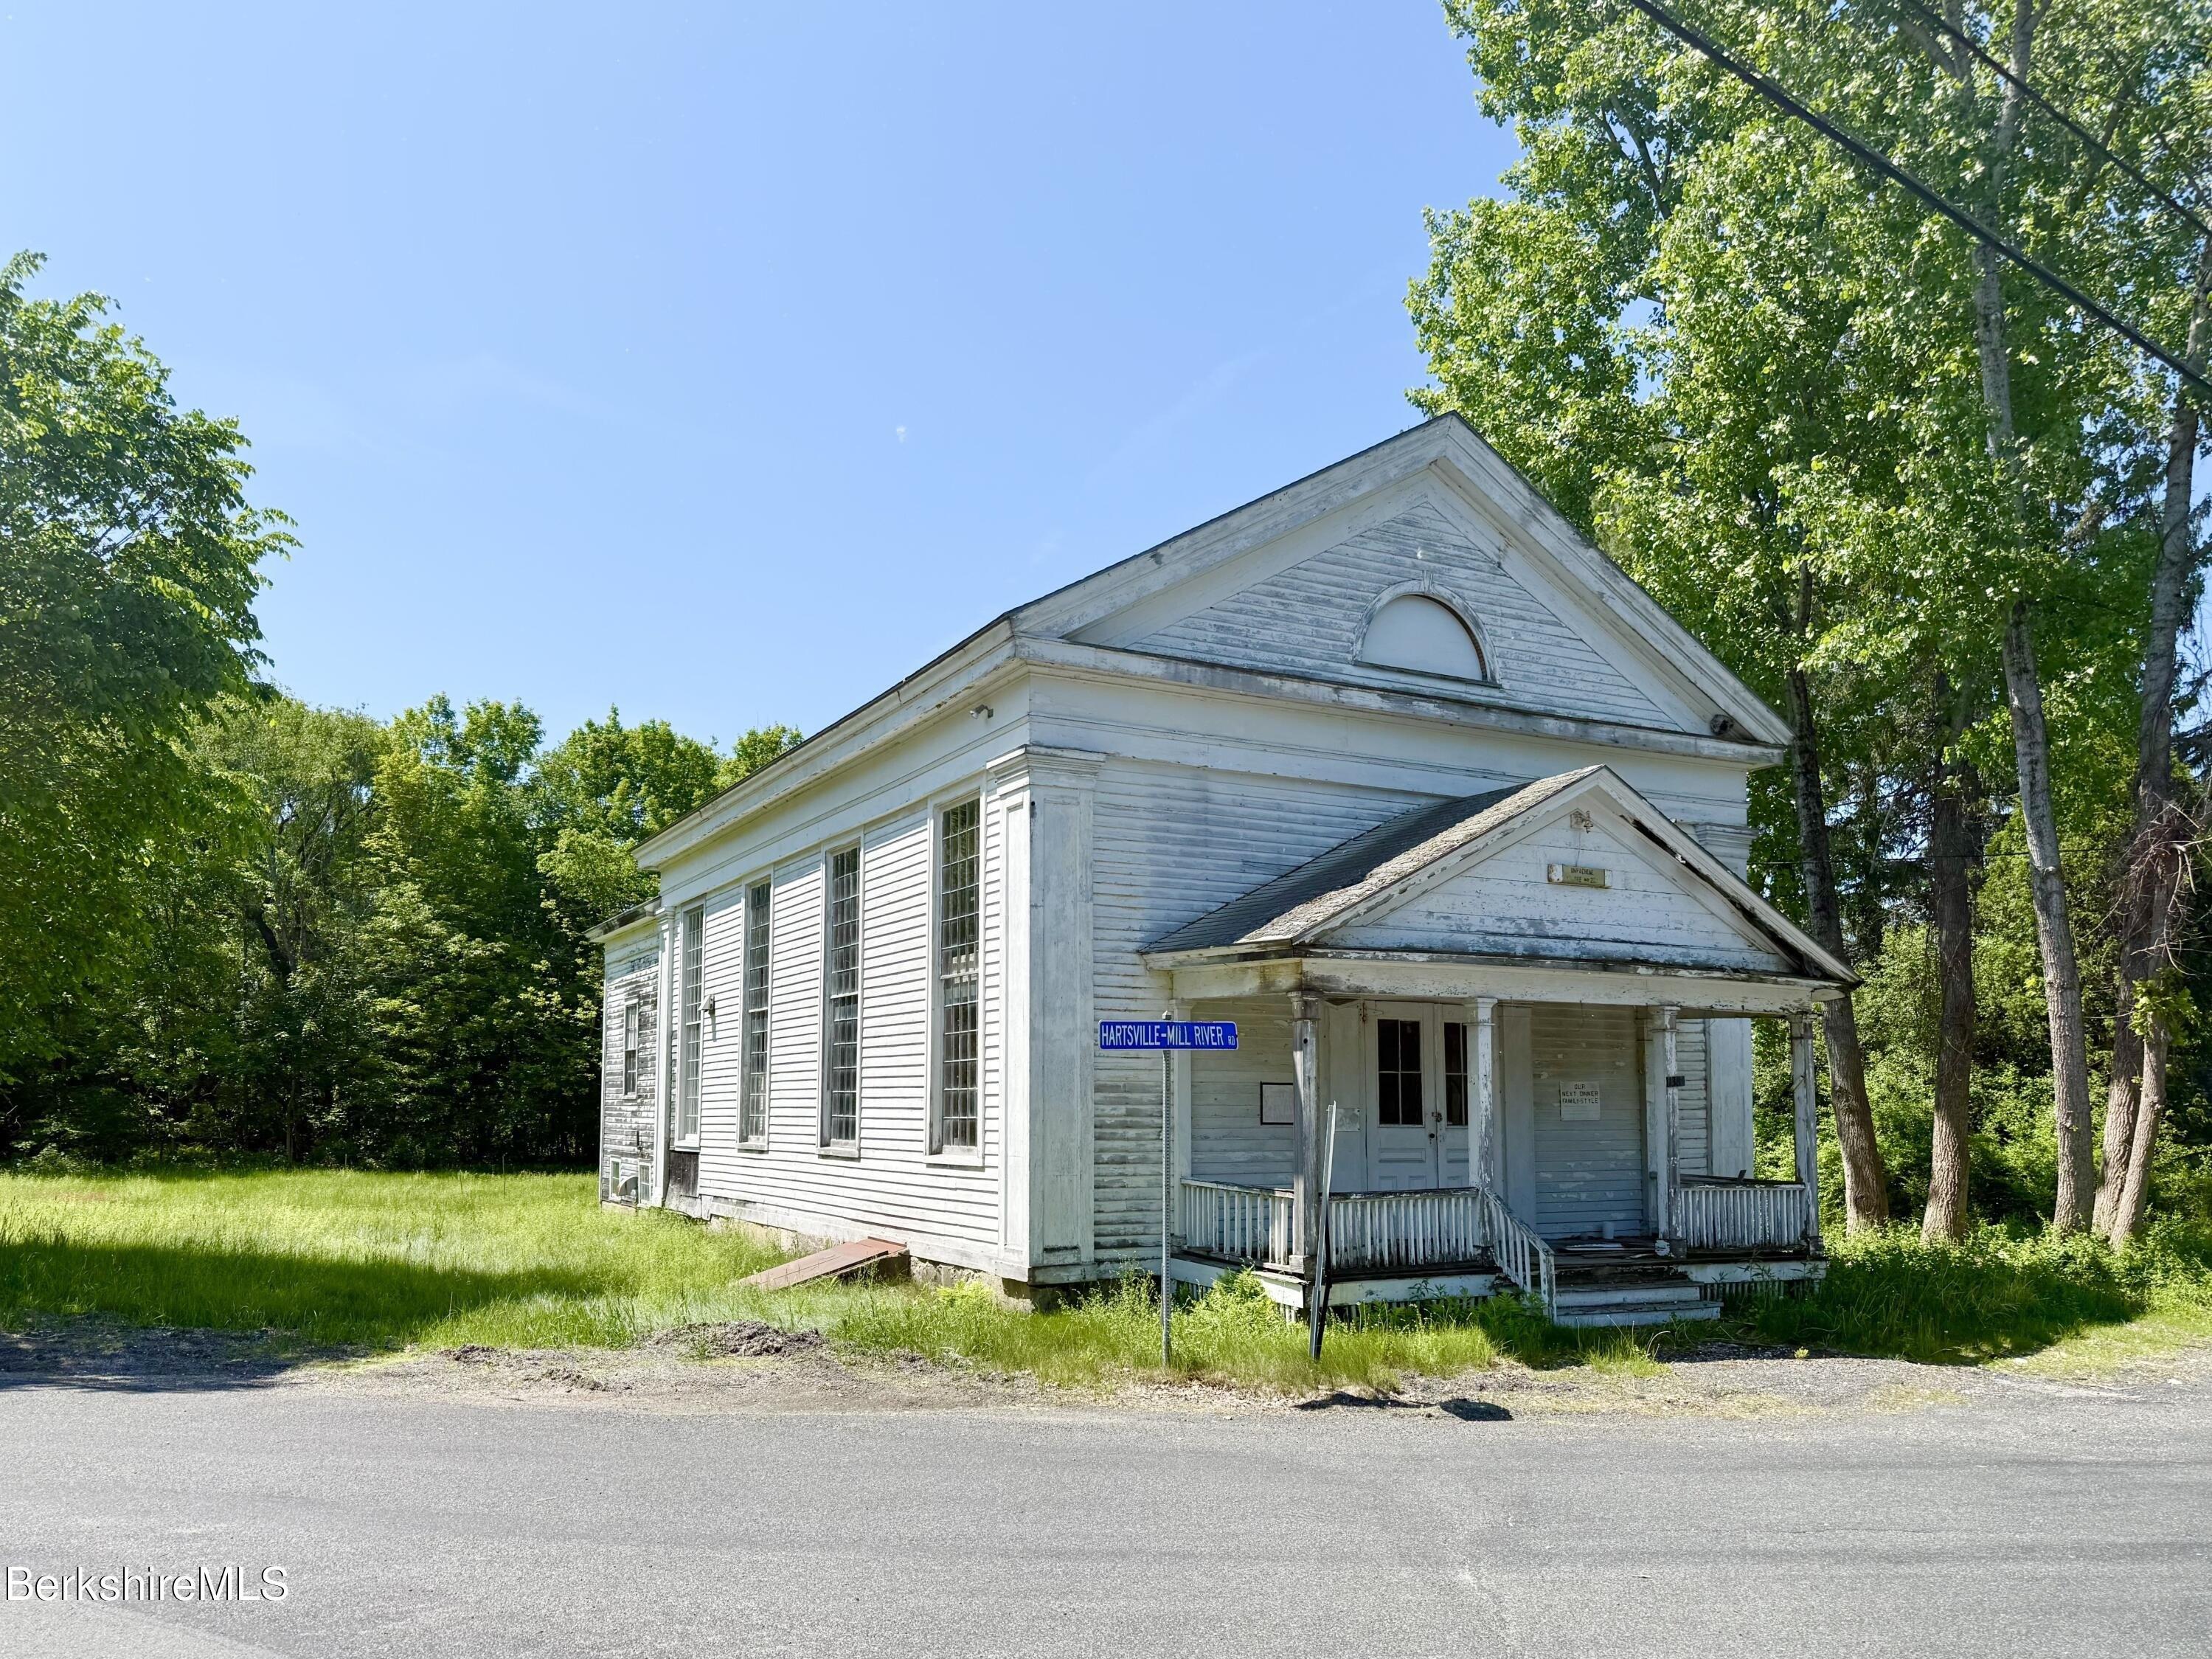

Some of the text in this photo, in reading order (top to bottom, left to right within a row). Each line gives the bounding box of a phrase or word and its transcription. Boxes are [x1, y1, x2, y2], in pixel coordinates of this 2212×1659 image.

[1101, 1025, 1235, 1046] HARTSVILLE-MILL RIVER RD
